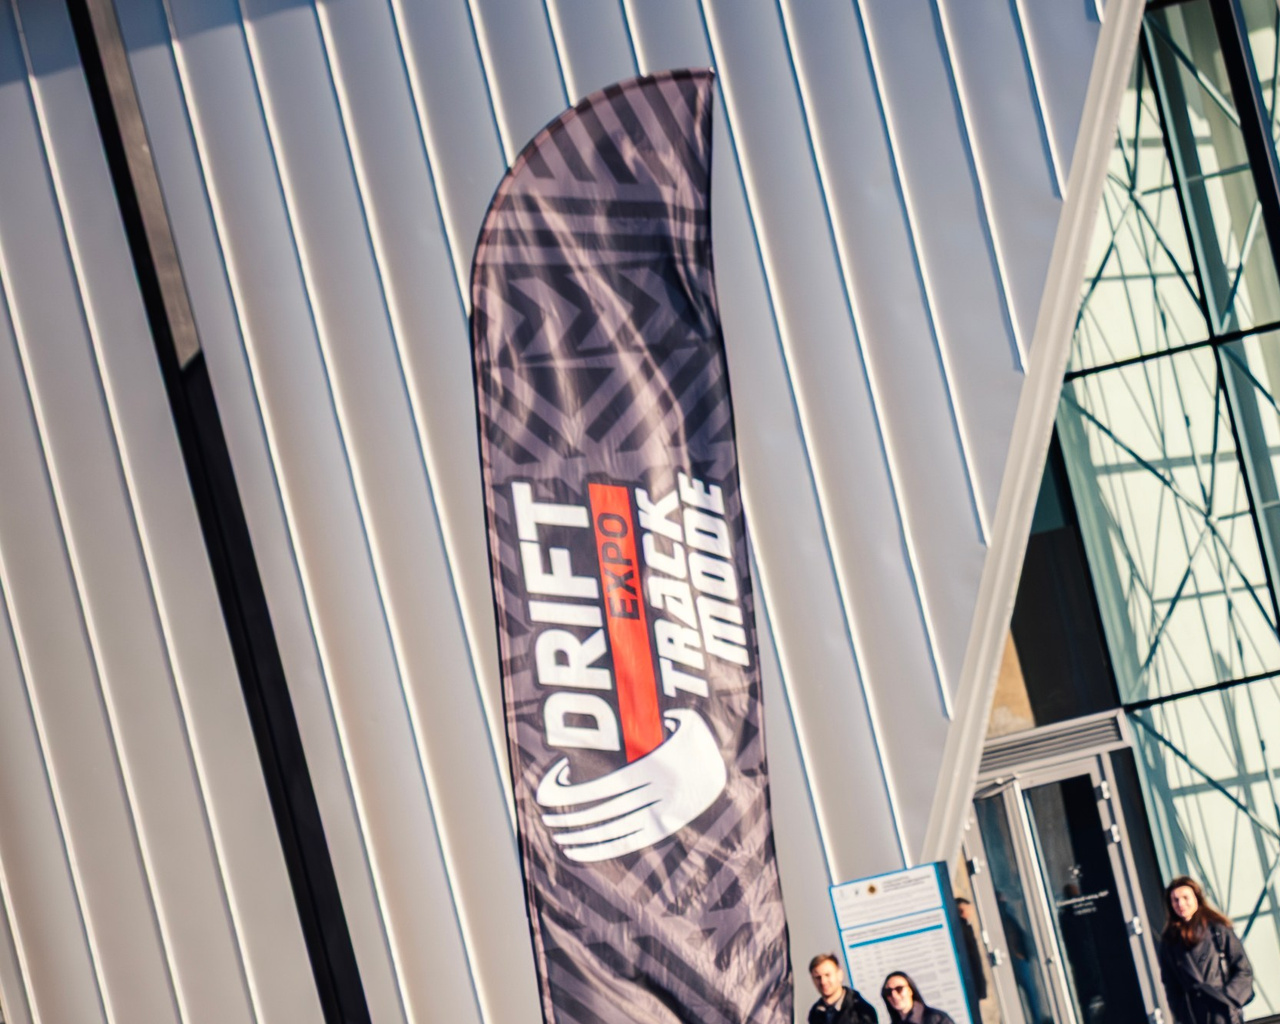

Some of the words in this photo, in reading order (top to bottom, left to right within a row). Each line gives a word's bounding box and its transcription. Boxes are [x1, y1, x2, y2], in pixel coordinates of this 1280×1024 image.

[512, 481, 622, 752] DRIFT
[596, 511, 641, 622] EXPO
[634, 487, 710, 698] TRACK
[677, 471, 751, 667] MODE
